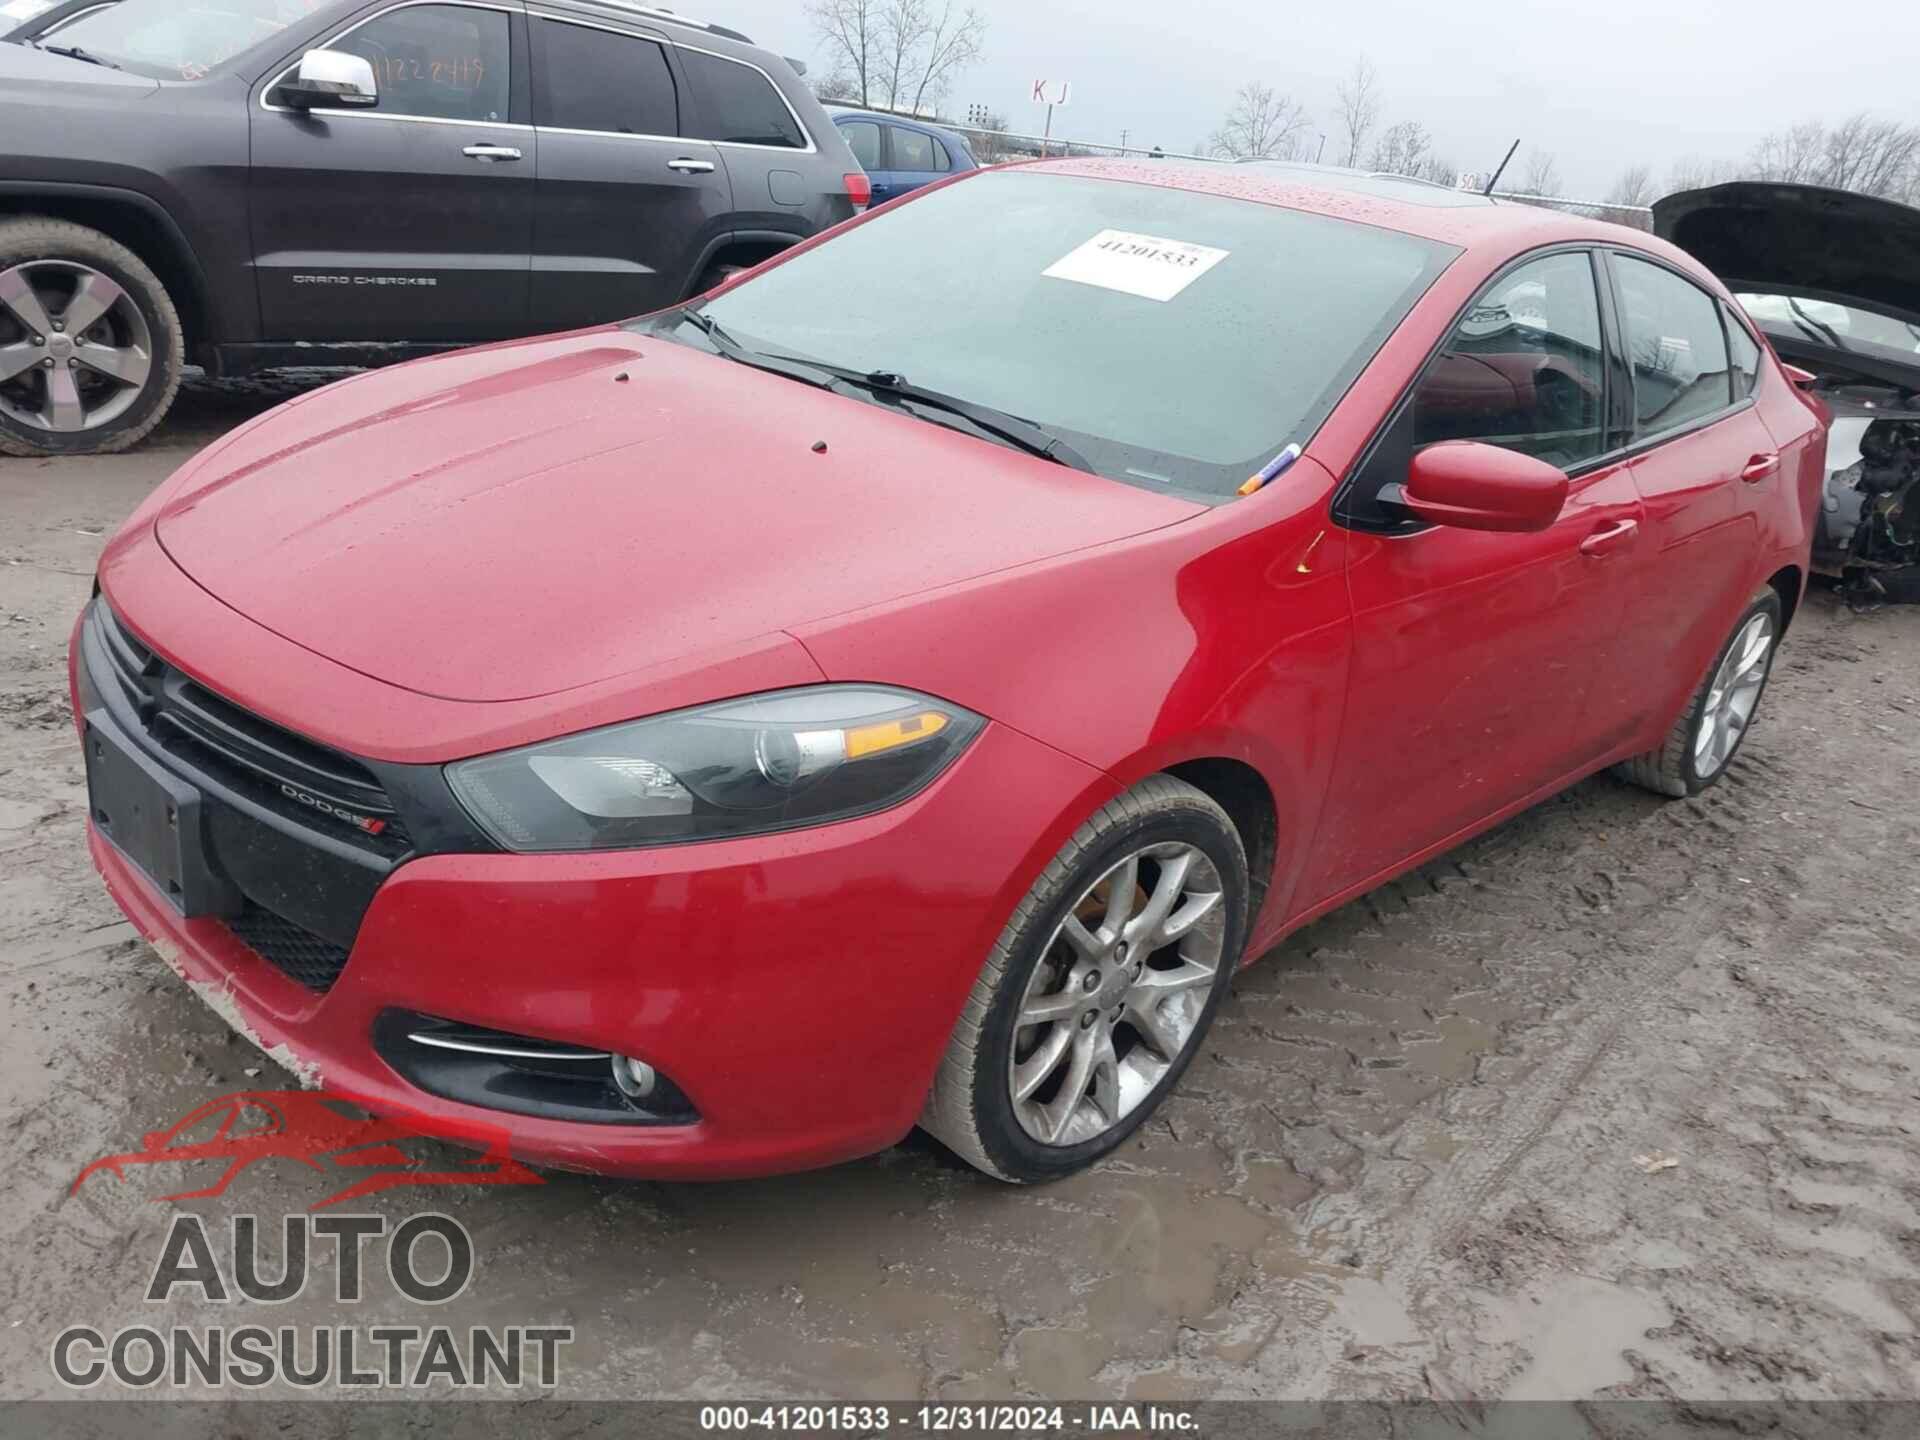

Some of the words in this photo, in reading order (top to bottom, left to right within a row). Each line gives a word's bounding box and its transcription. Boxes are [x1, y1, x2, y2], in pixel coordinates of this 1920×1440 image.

[1032, 79, 1047, 102] K
[292, 274, 350, 284] GRAND
[353, 276, 437, 286] CHEROKEE
[281, 784, 370, 828] DODGE
